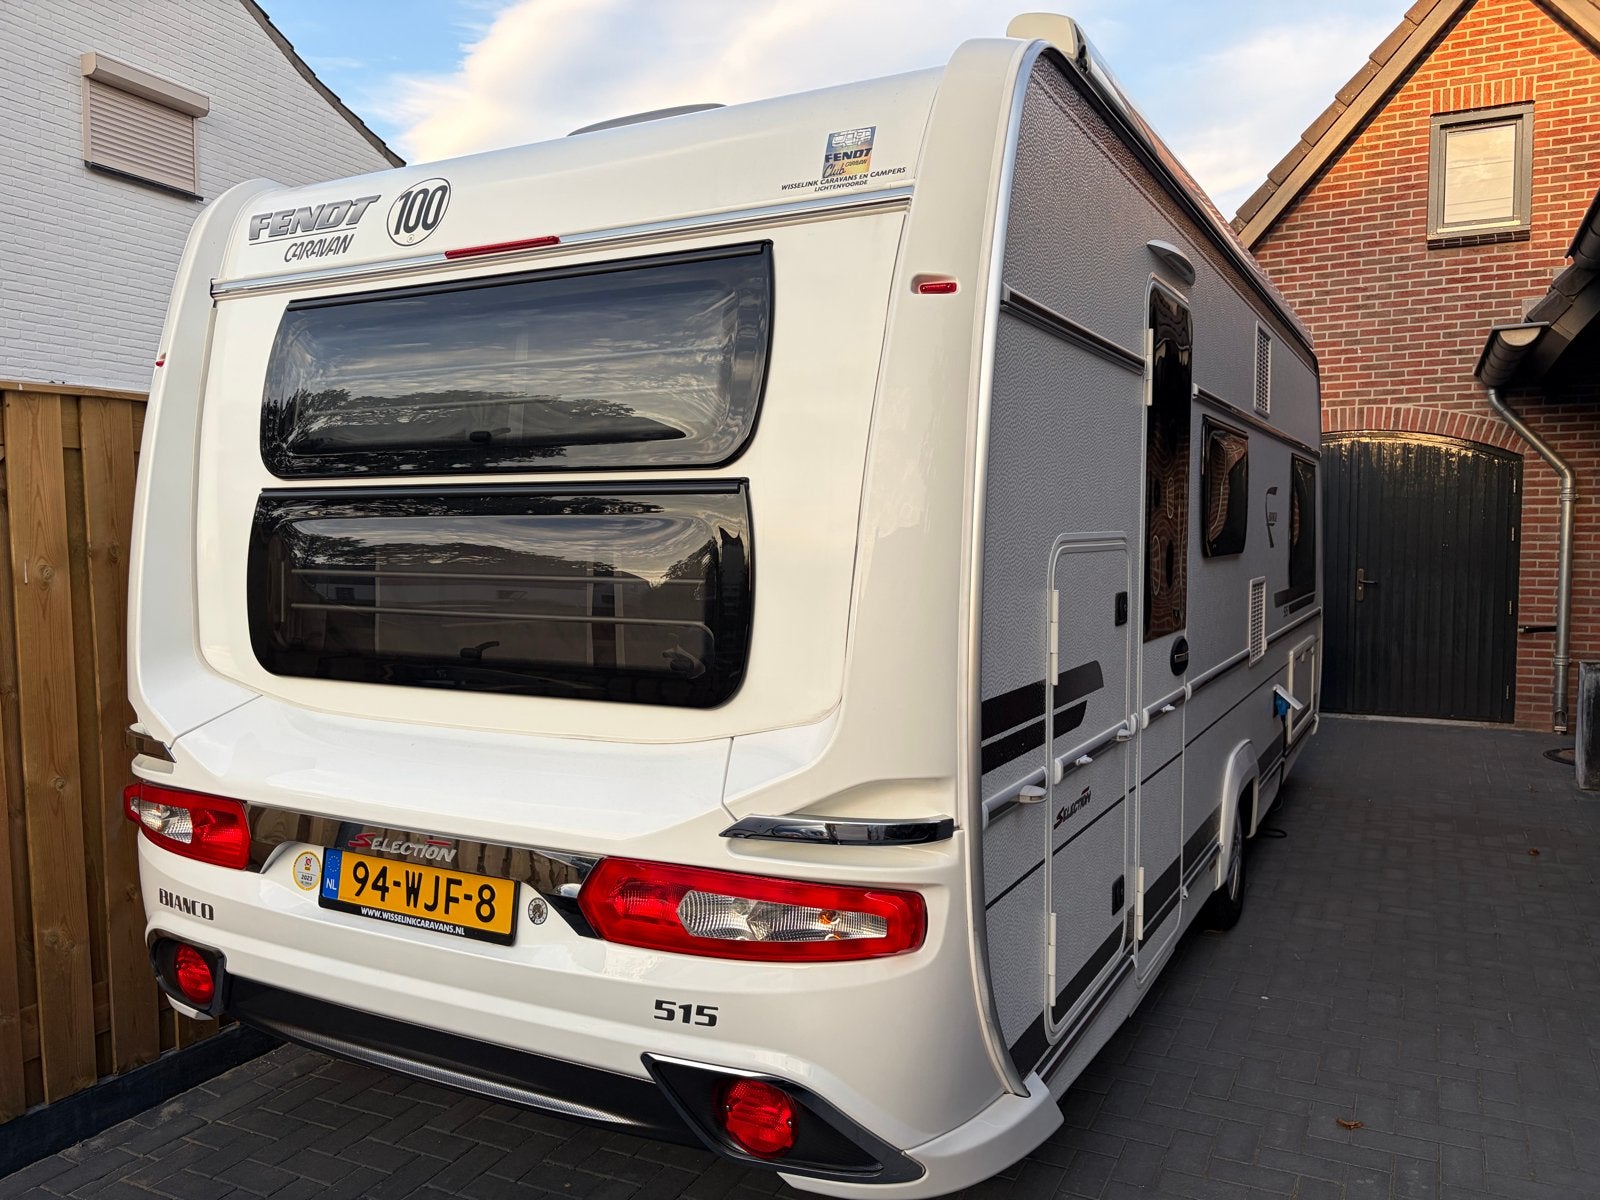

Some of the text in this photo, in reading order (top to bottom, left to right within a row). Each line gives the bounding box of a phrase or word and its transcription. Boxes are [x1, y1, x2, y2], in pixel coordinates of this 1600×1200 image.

[825, 147, 873, 163] FENDT
[781, 180, 819, 190] WISSELINK
[820, 174, 858, 185] CARAVANS
[870, 166, 907, 178] CAMPERS
[822, 162, 847, 179] Club
[814, 180, 868, 192] LICHTENVOORDE
[248, 194, 382, 241] FENDT
[393, 184, 448, 236] 100
[284, 233, 355, 262] CARAVAN
[347, 831, 457, 863] SELECTION
[301, 873, 313, 882] 2023
[325, 877, 337, 891] NL
[352, 860, 497, 923] 94-WJF-8
[159, 887, 215, 921] BIANCO
[360, 906, 466, 936] WWW.WISSELINKCARAVANS.NL
[653, 999, 719, 1027] 515
